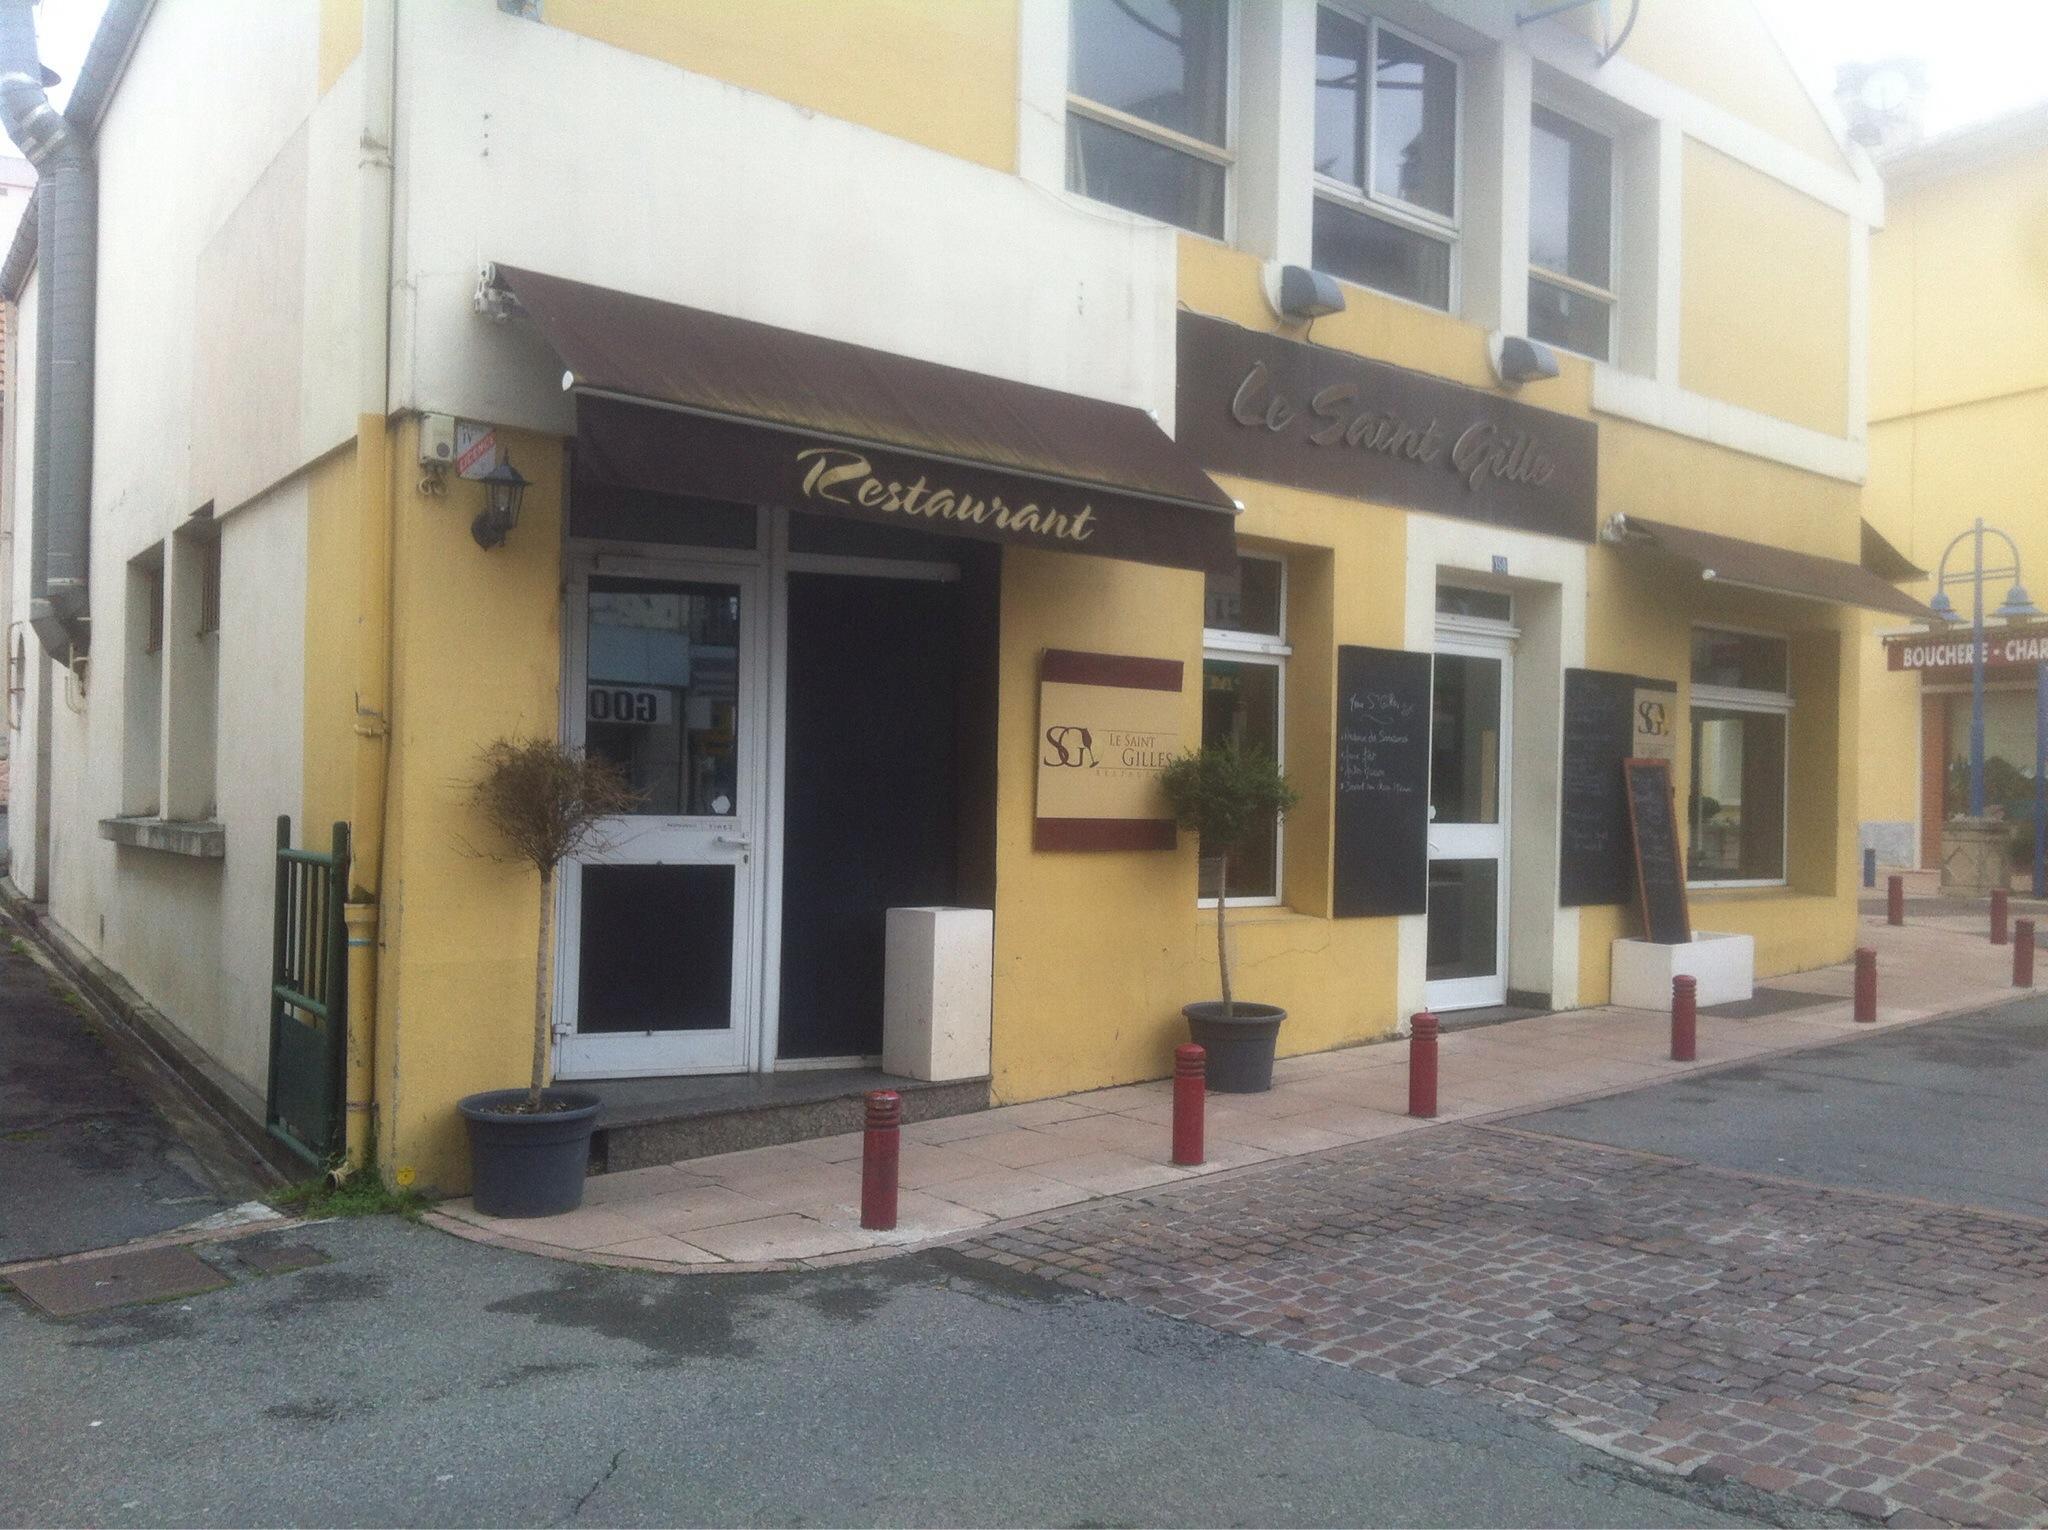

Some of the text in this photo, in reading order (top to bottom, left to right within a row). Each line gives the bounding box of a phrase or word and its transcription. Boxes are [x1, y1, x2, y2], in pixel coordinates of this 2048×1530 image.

[1232, 360, 1296, 432] Le
[1309, 383, 1441, 462] Saint
[797, 449, 1096, 541] Restaurant
[1903, 642, 1989, 668] BOUCHERE
[1109, 733, 1156, 748] LE SAINT
[1122, 748, 1173, 768] GILLES
